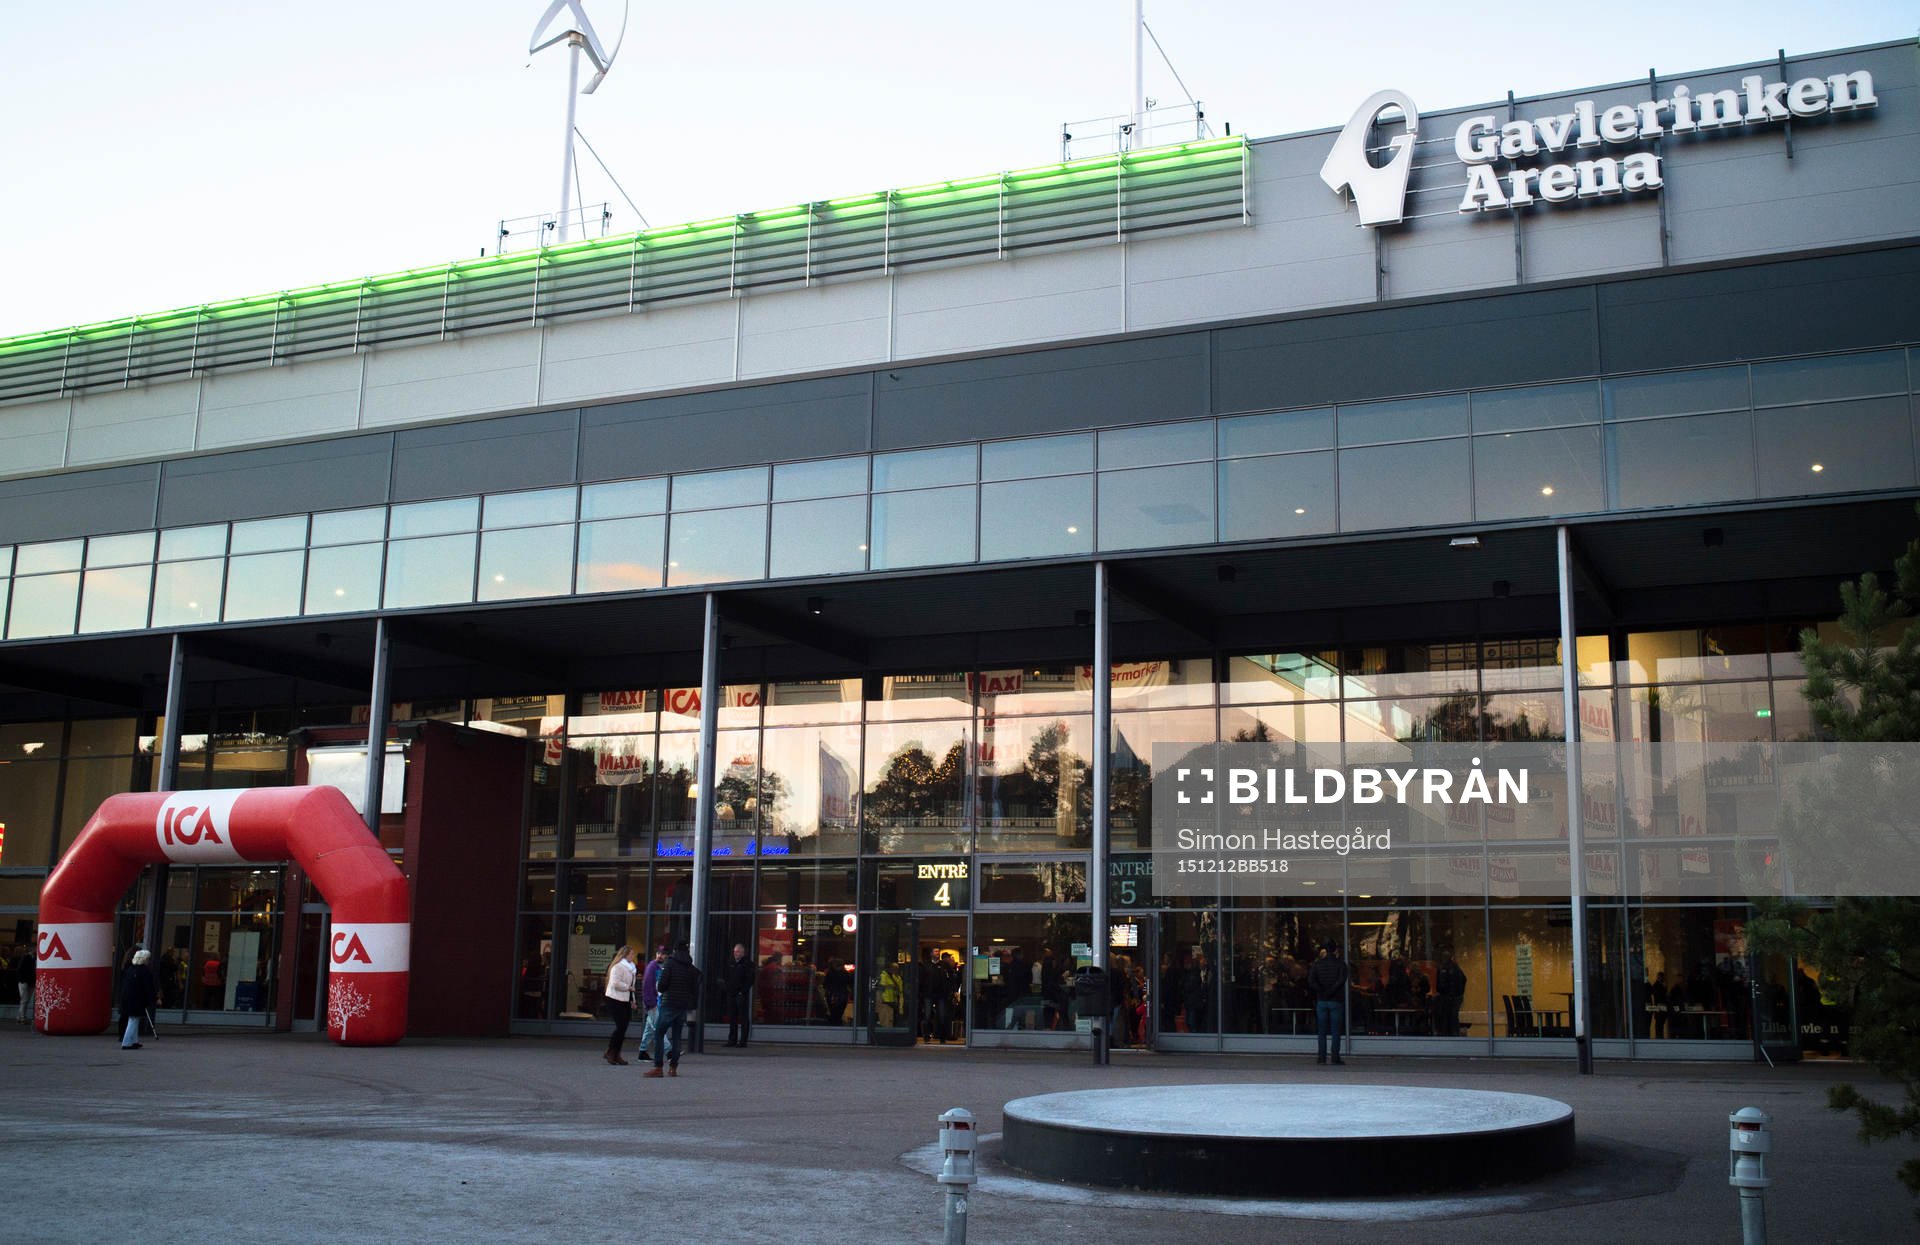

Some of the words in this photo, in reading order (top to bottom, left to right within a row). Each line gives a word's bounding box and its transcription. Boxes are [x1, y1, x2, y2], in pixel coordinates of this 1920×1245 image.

[1455, 69, 1879, 165] Gavlerinken
[1458, 151, 1665, 214] Arena
[1082, 661, 1162, 682] Sermarket
[601, 690, 643, 706] MAXI
[664, 689, 702, 714] ICA
[737, 692, 760, 707] ICA
[164, 806, 223, 846] ICA
[934, 882, 951, 907] 4
[1121, 881, 1137, 905] 5
[38, 931, 72, 962] CA
[330, 932, 373, 965] CA
